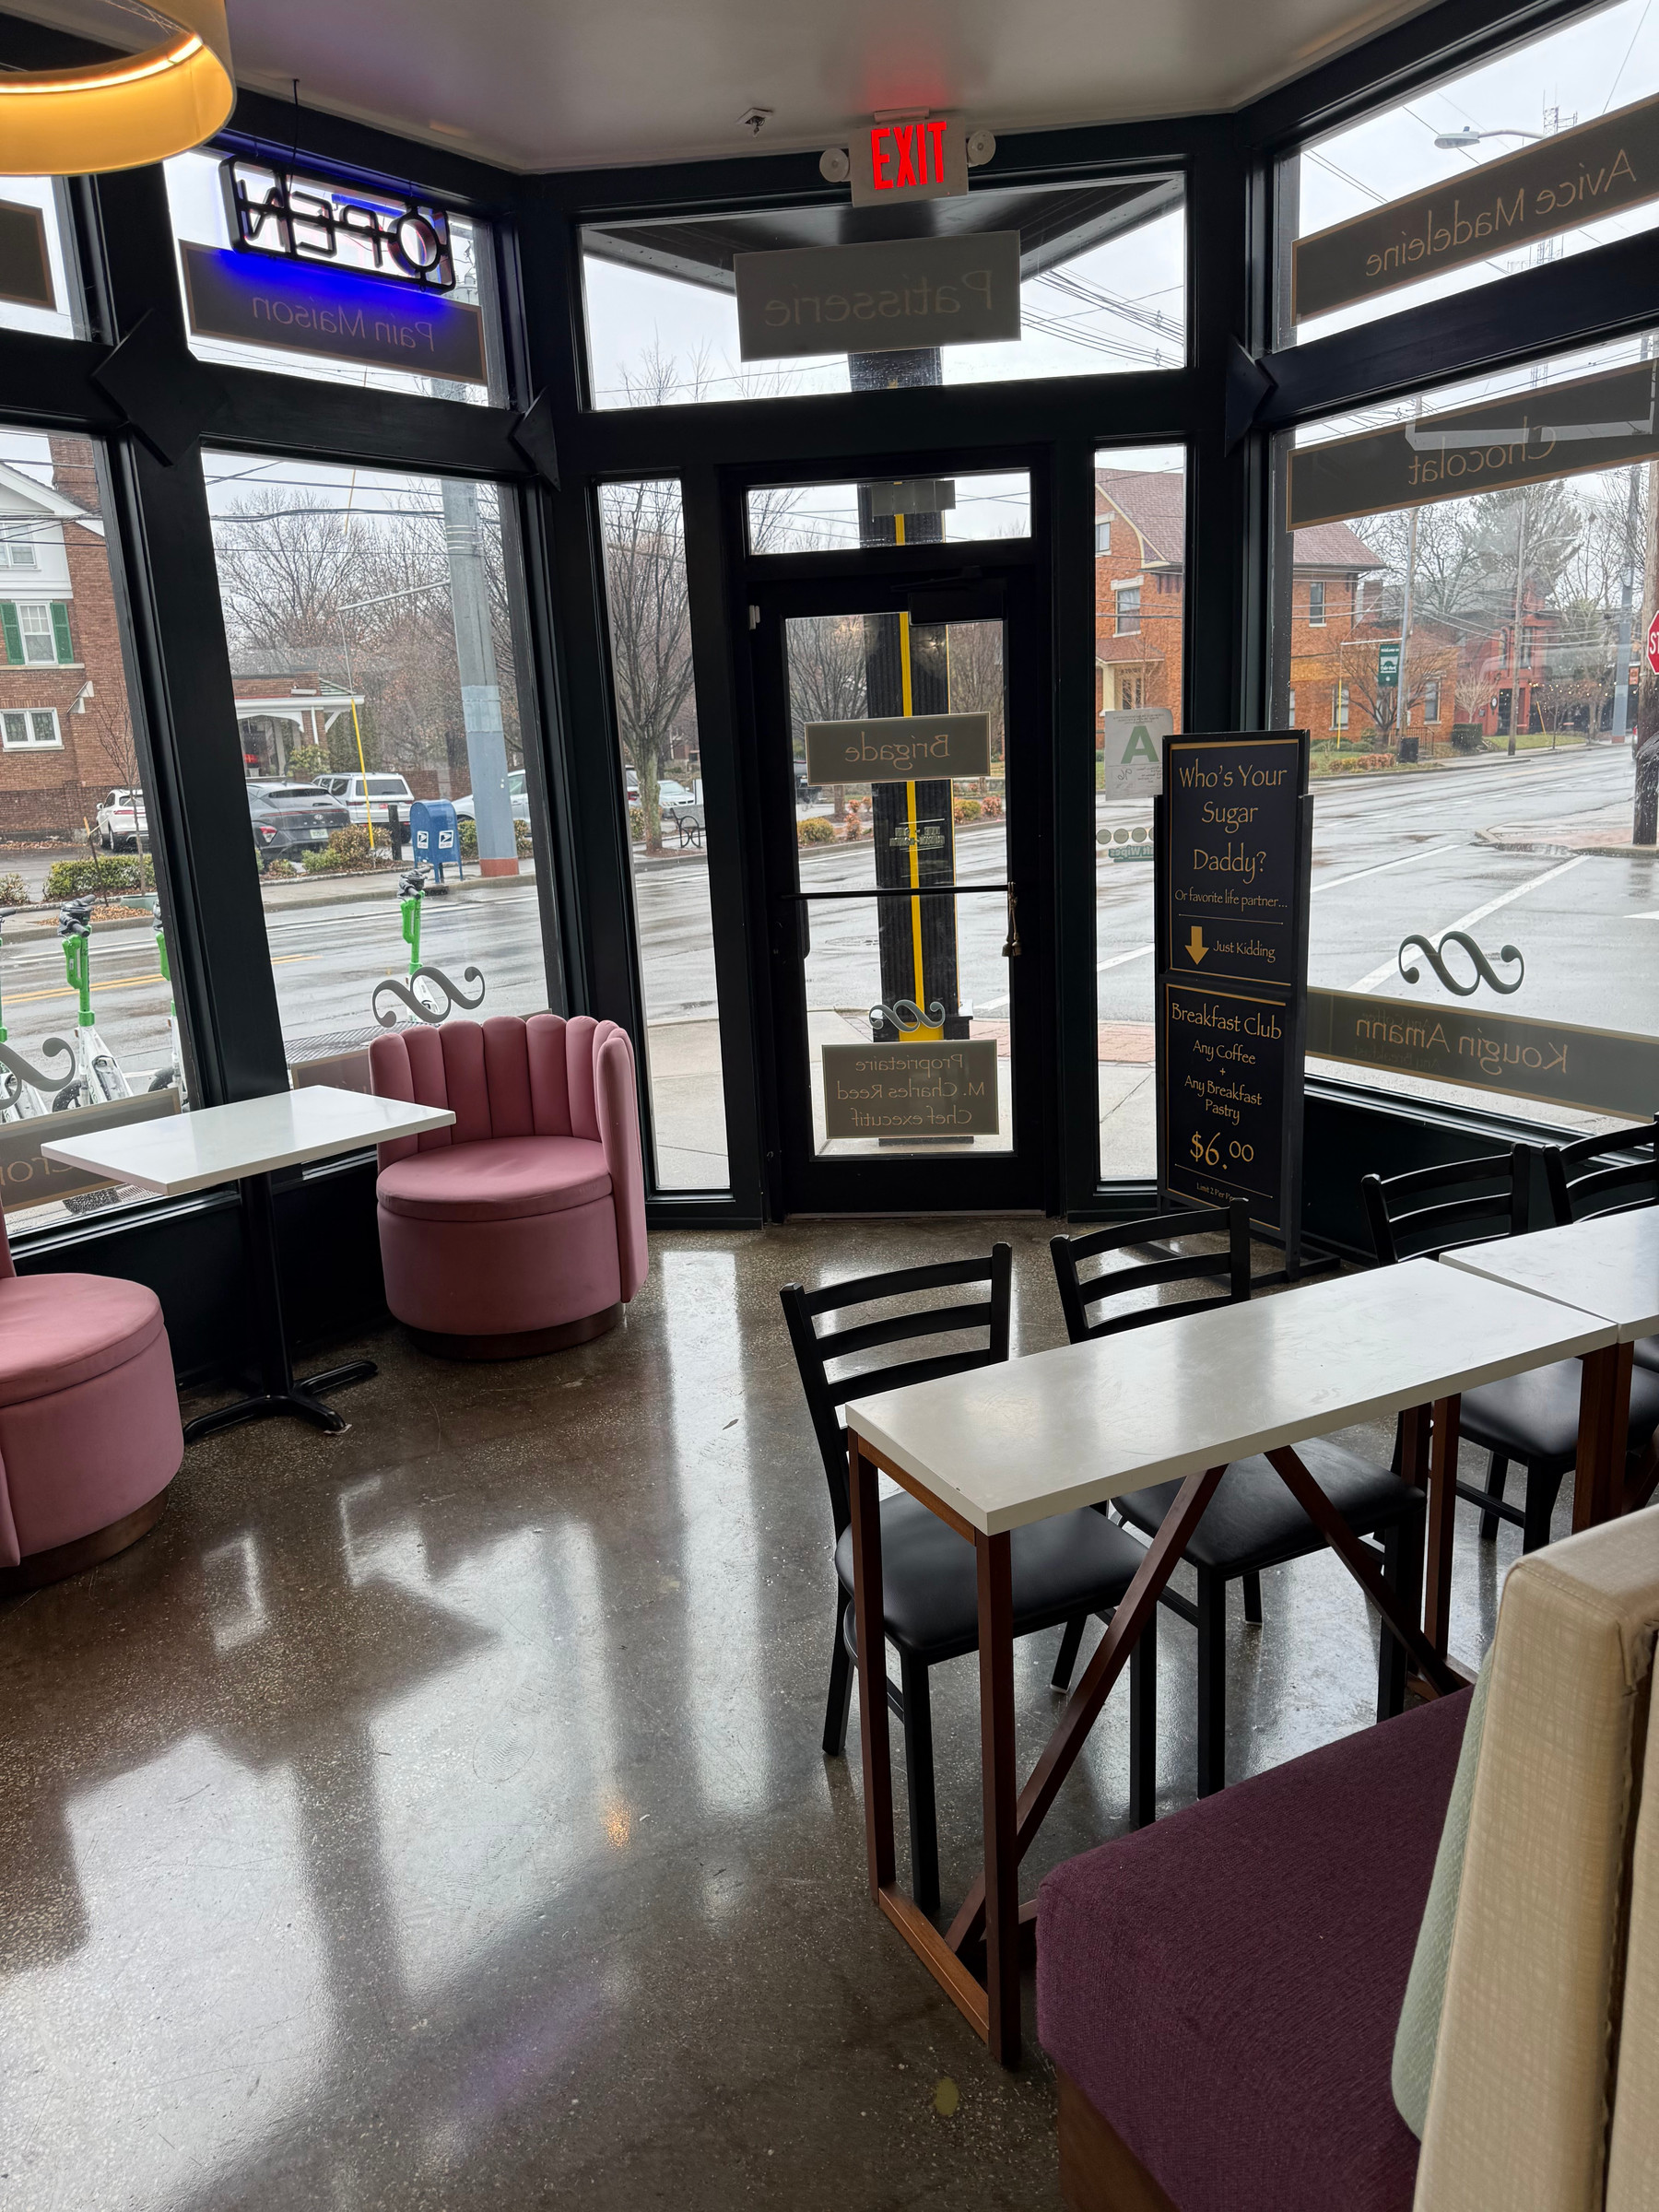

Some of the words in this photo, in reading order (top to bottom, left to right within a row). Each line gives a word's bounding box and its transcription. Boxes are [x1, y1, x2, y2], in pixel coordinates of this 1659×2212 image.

[871, 121, 947, 190] EXIT
[1179, 758, 1234, 788] Who's
[1238, 764, 1288, 787] Your
[1201, 801, 1259, 834] Sugar
[1193, 841, 1267, 885] Daddy?
[1174, 889, 1188, 901] Or
[1189, 887, 1224, 904] favorite
[1224, 888, 1240, 905] life
[1241, 896, 1288, 912] partner...
[1213, 940, 1235, 955] Just
[1236, 941, 1277, 964] Kidding
[1171, 1002, 1241, 1032] Breakfast
[1243, 1012, 1282, 1040] Club
[1192, 1040, 1215, 1062] Any
[1216, 1042, 1256, 1065] Coffee
[1184, 1075, 1206, 1098] Any
[1206, 1079, 1263, 1106] Breakfast
[1205, 1099, 1241, 1126] Pastry
[1189, 1130, 1254, 1170] $6.00
